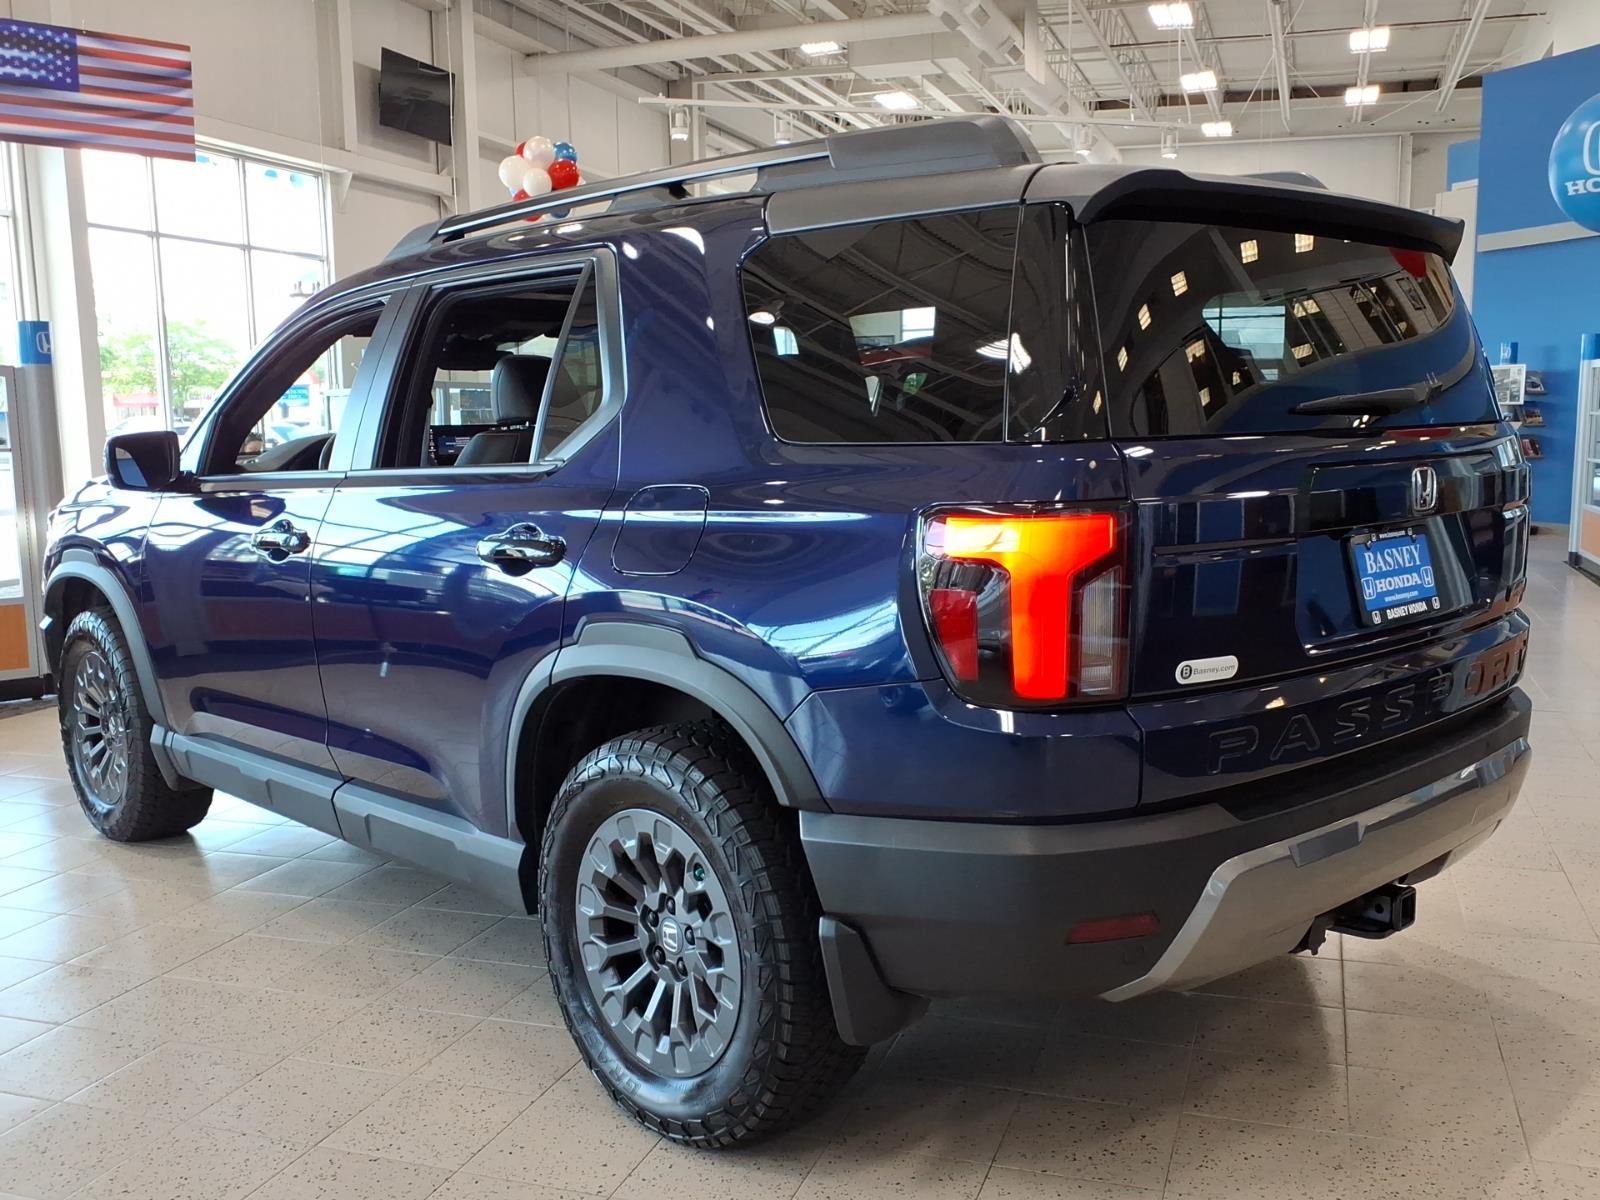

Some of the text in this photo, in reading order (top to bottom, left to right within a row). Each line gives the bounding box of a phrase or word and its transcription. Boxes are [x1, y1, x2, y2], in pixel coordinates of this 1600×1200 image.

[1364, 544, 1422, 574] BASNEY
[1375, 573, 1422, 593] HONDA
[1386, 601, 1428, 620] BASNEY HONDA
[1193, 664, 1236, 676] Basney.com
